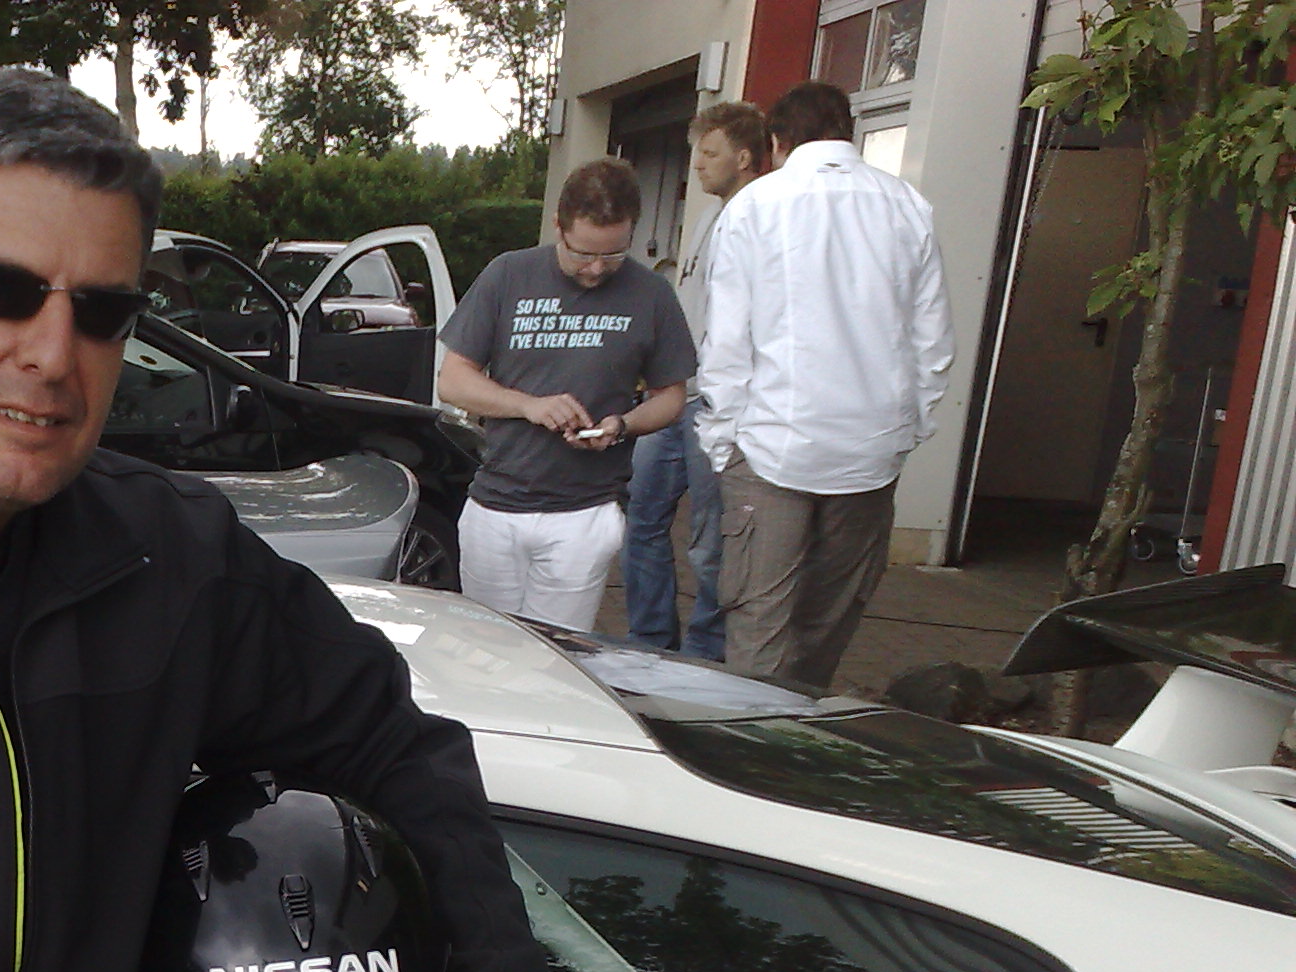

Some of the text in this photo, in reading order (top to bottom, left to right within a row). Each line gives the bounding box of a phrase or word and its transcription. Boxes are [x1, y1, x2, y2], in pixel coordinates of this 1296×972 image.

[516, 298, 563, 315] SO FAR,
[512, 314, 632, 332] THIS IS THE OLDEST
[509, 331, 604, 350] I'VE EVER BEEN.
